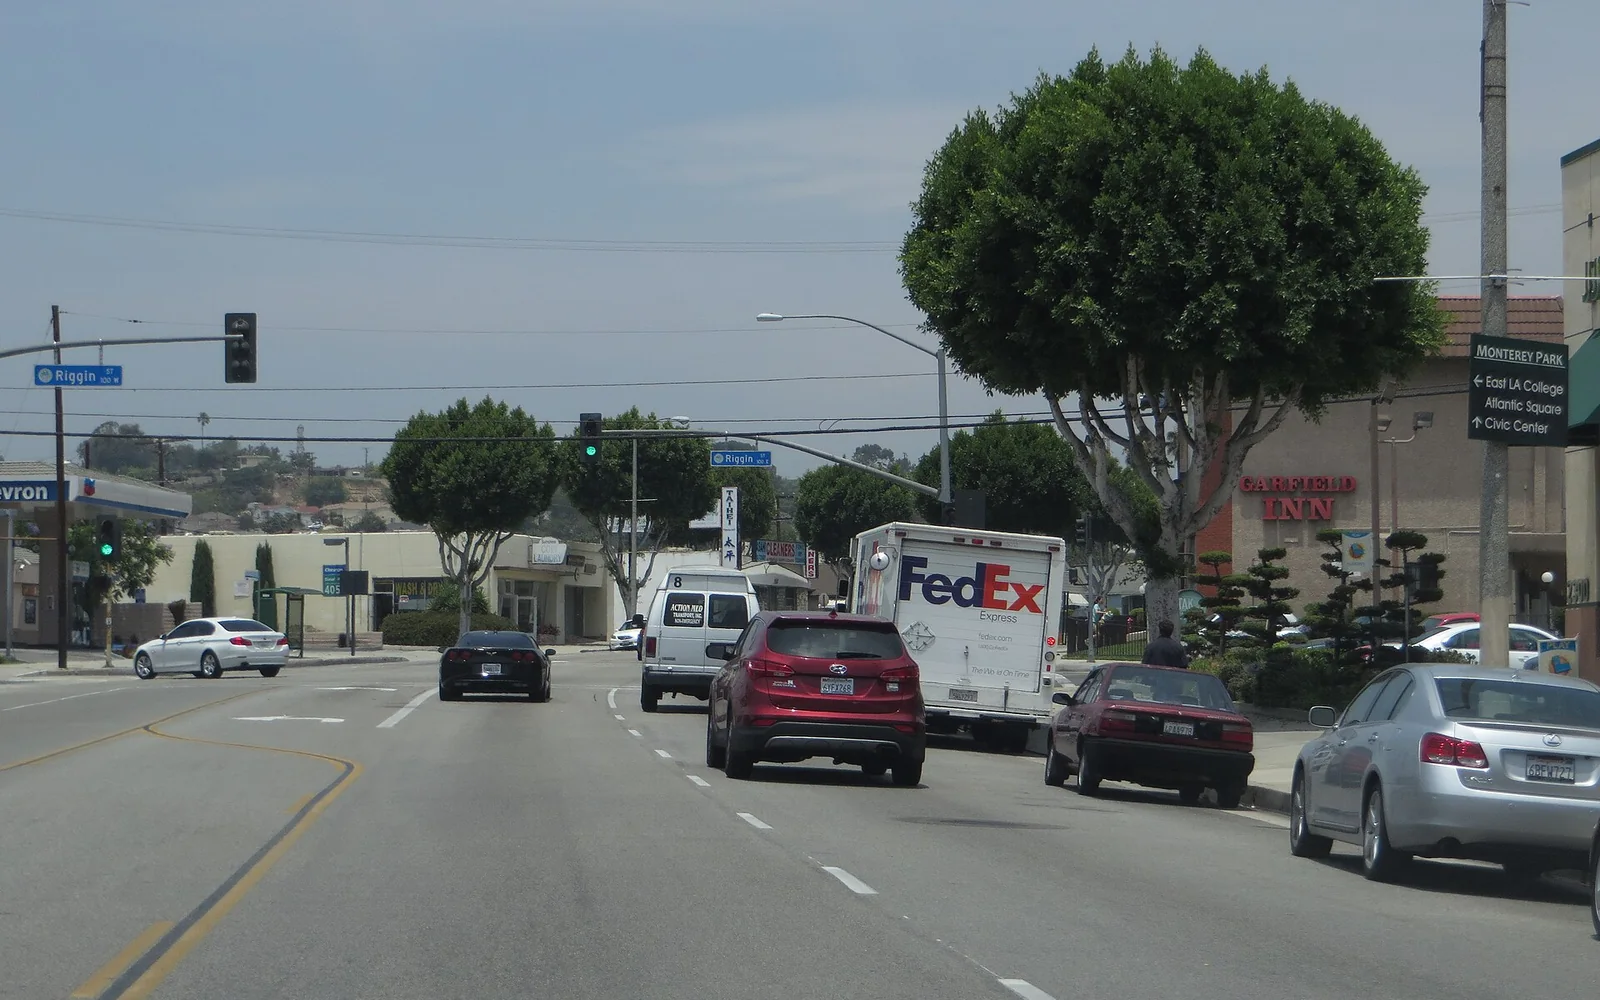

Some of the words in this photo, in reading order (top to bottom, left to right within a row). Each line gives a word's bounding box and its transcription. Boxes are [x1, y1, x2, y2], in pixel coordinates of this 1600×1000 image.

[1476, 344, 1533, 362] MONTEREY
[1535, 351, 1563, 366] PARK
[55, 370, 96, 384] Riggin
[1486, 376, 1506, 389] East
[1509, 378, 1521, 391] LA
[1523, 380, 1563, 397] College
[1485, 397, 1523, 411] Atlantic
[1526, 400, 1561, 415] Square
[1484, 417, 1511, 430] Civic
[1513, 420, 1548, 434] Center
[725, 454, 753, 465] Riggin
[1239, 475, 1357, 492] GARFIELD
[0, 486, 48, 500] vron
[725, 489, 734, 526] TAIHEI
[1263, 498, 1335, 520] INN
[724, 536, 736, 562] 太平
[766, 542, 795, 557] CLEANERS
[395, 582, 417, 596] WASH
[674, 576, 682, 587] 8
[900, 554, 1045, 614] FedEx
[324, 585, 341, 595] 405
[670, 603, 690, 612] ACTION
[980, 610, 1017, 623] Express
[971, 666, 983, 674] The
[984, 667, 1002, 675] Wold
[1003, 669, 1013, 677] On
[1014, 670, 1030, 678] Time
